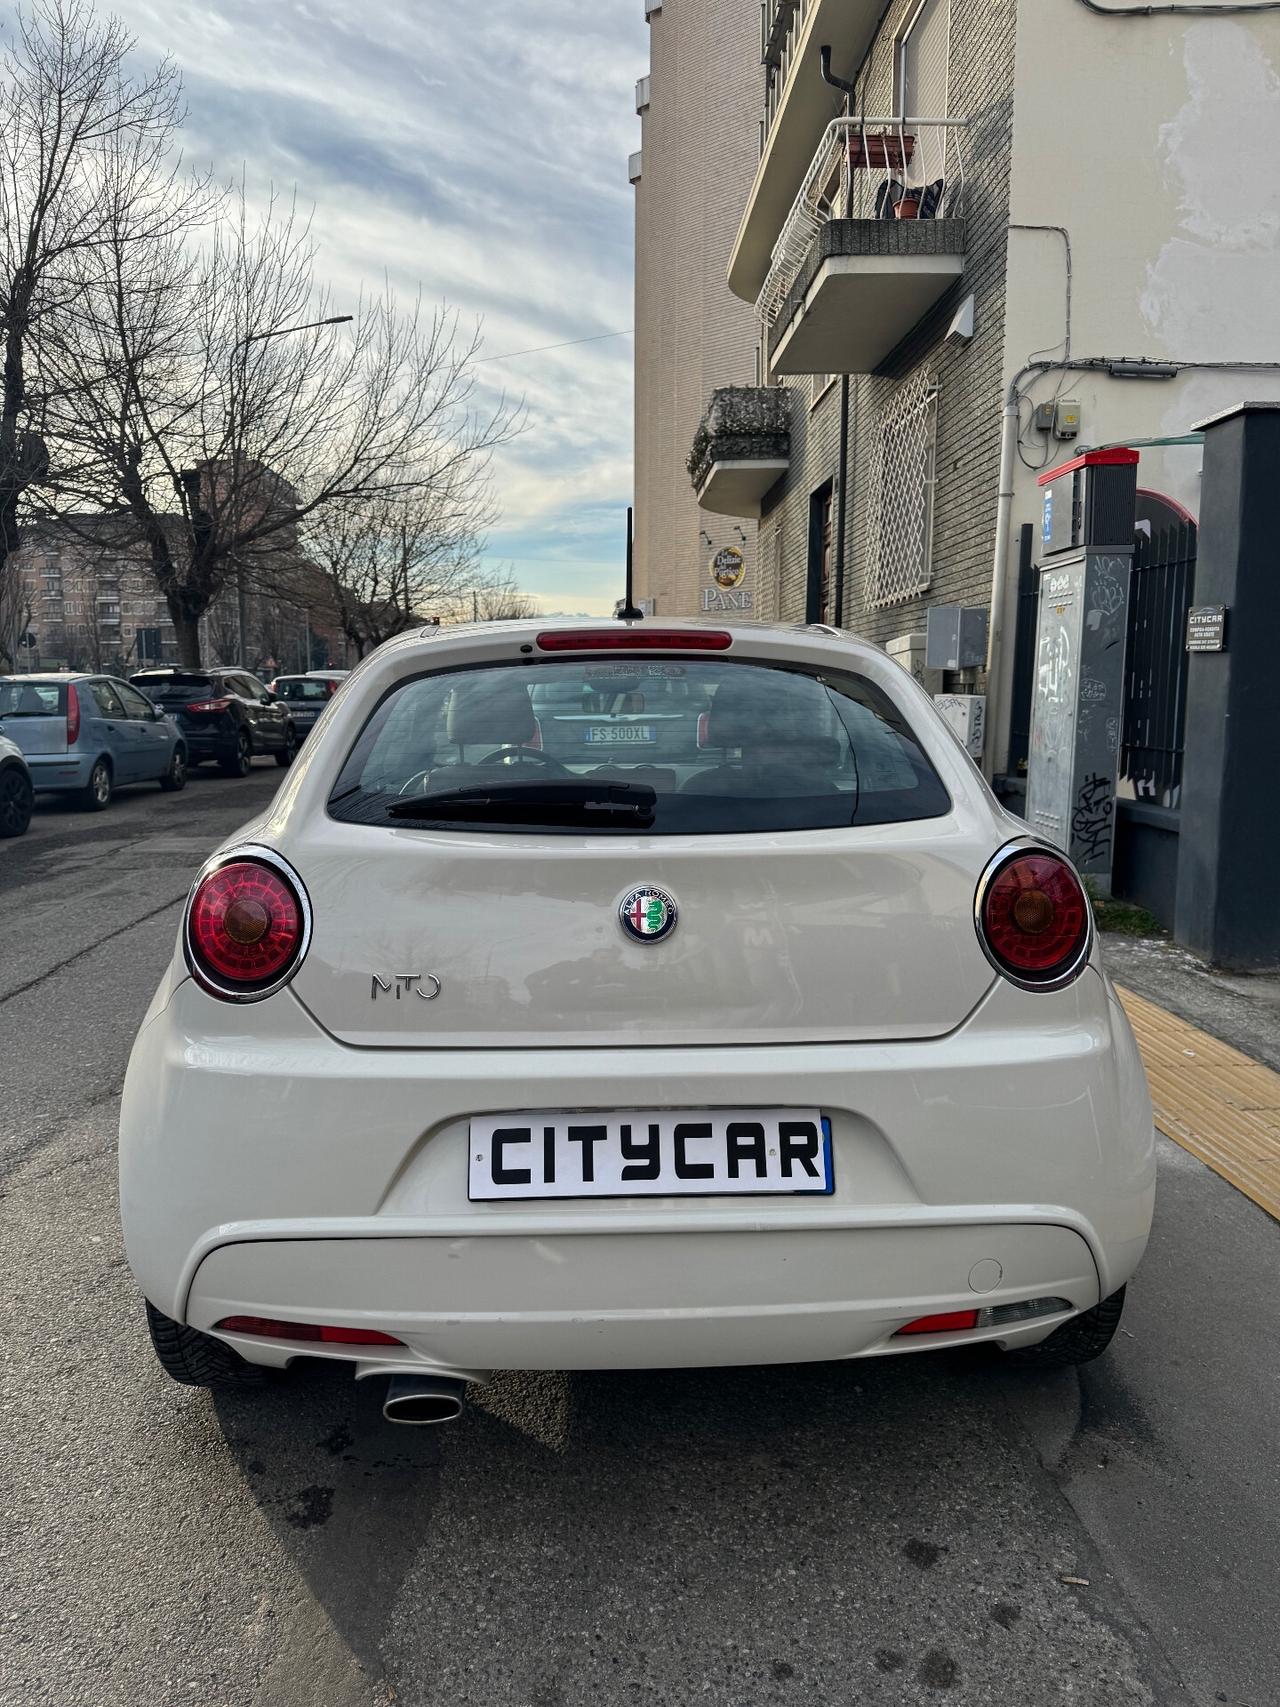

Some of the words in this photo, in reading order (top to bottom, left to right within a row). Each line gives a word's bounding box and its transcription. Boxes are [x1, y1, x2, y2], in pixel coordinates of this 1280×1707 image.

[1189, 615, 1223, 624] CITYCAR
[592, 727, 606, 740] FS
[623, 892, 642, 916] ALFA
[644, 889, 676, 915] ROMEO
[491, 1121, 821, 1185] CITYCAR
